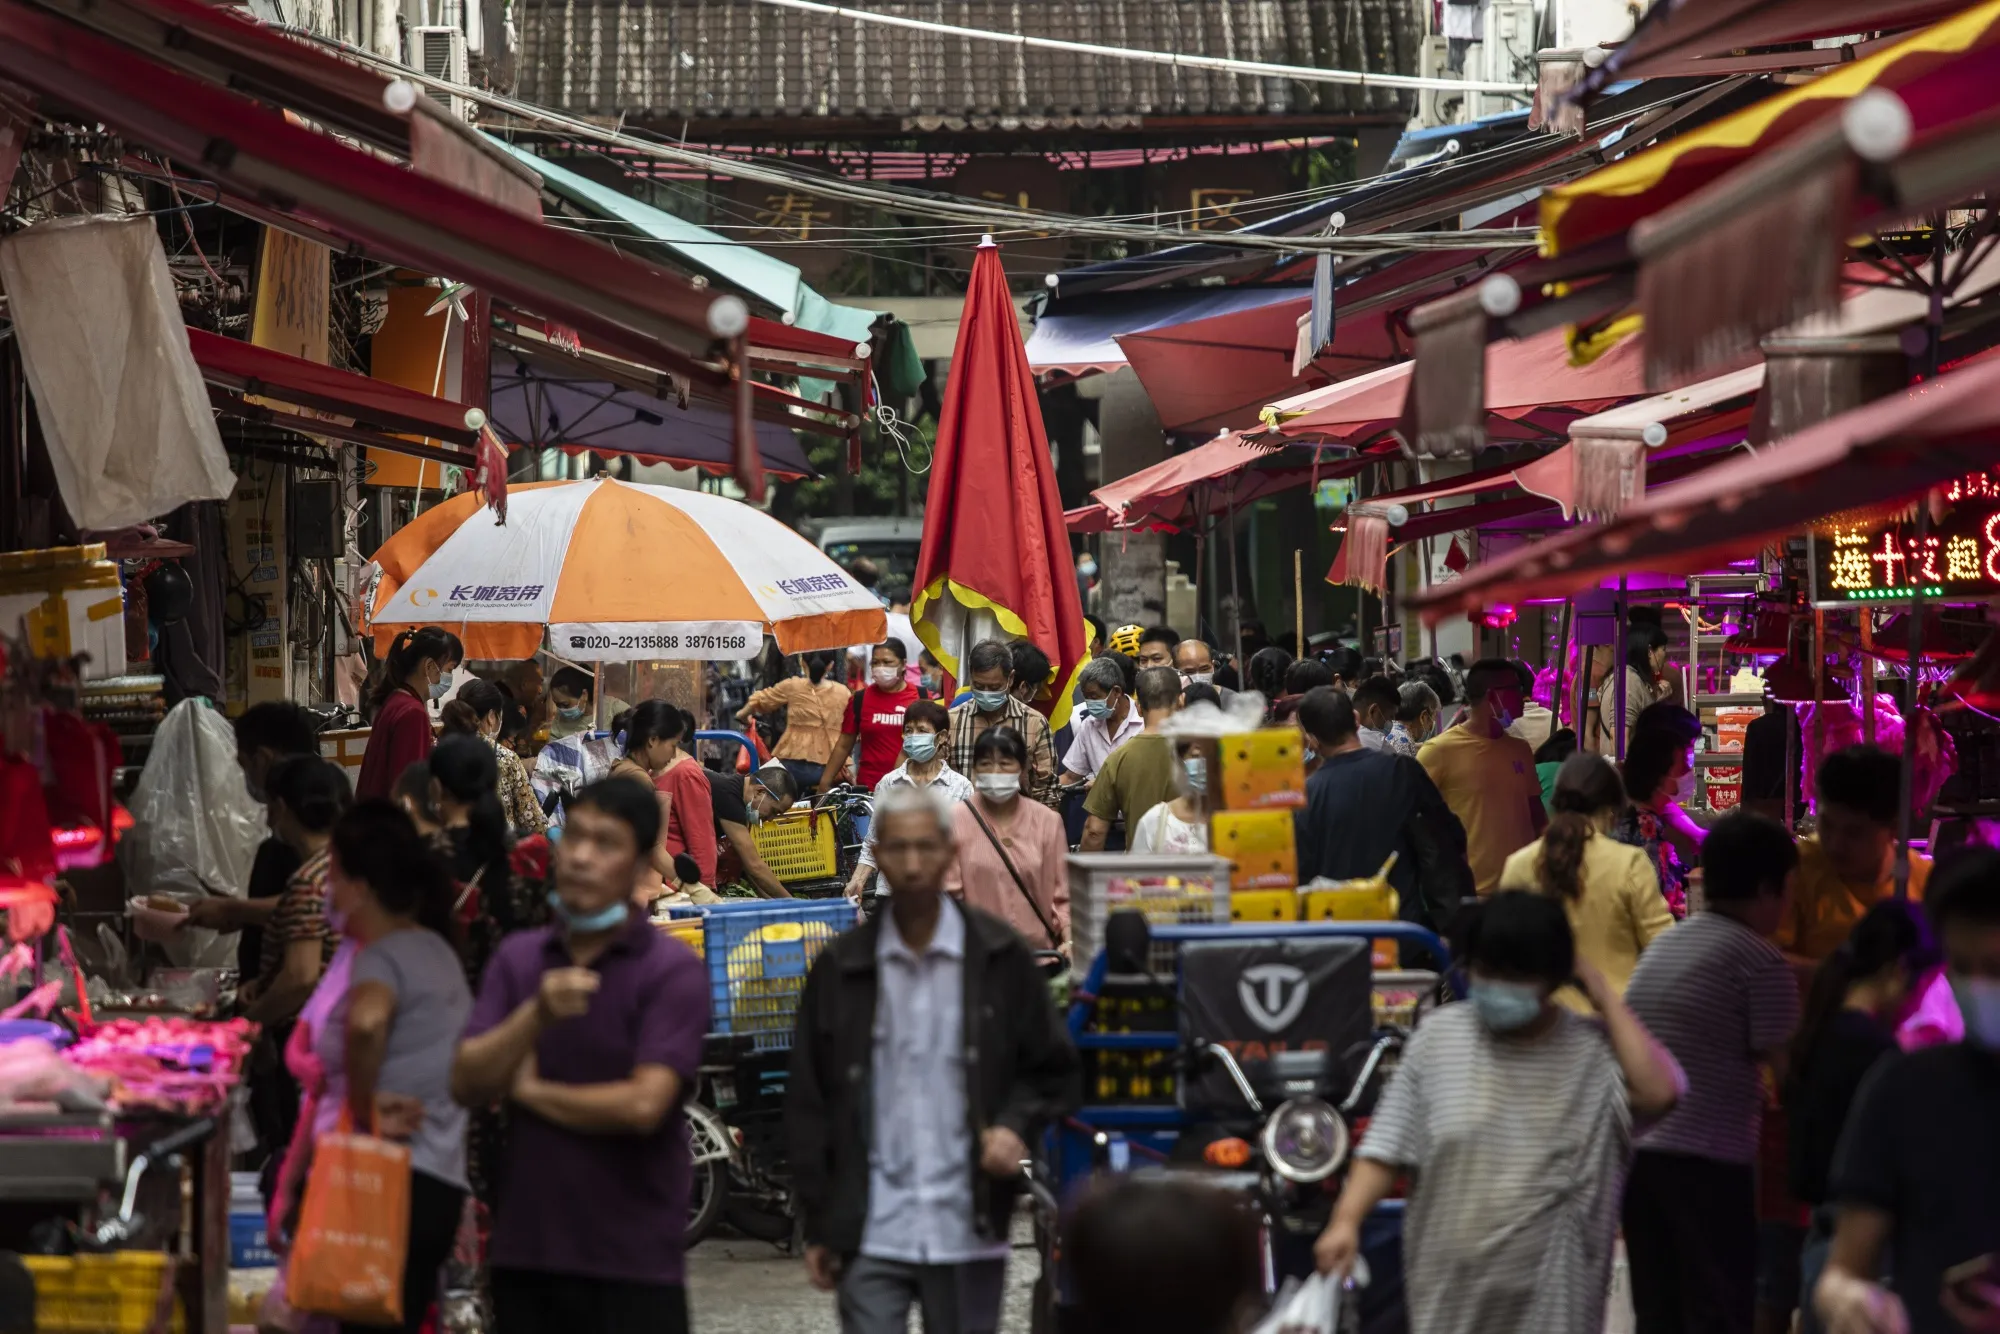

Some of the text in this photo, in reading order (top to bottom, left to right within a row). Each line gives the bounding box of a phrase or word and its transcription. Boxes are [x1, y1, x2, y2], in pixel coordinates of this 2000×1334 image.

[776, 573, 848, 595] 长城宽带
[449, 584, 544, 601] 长城宽带
[587, 635, 746, 649] 020-22135888 38761568
[872, 713, 904, 725] PUM
